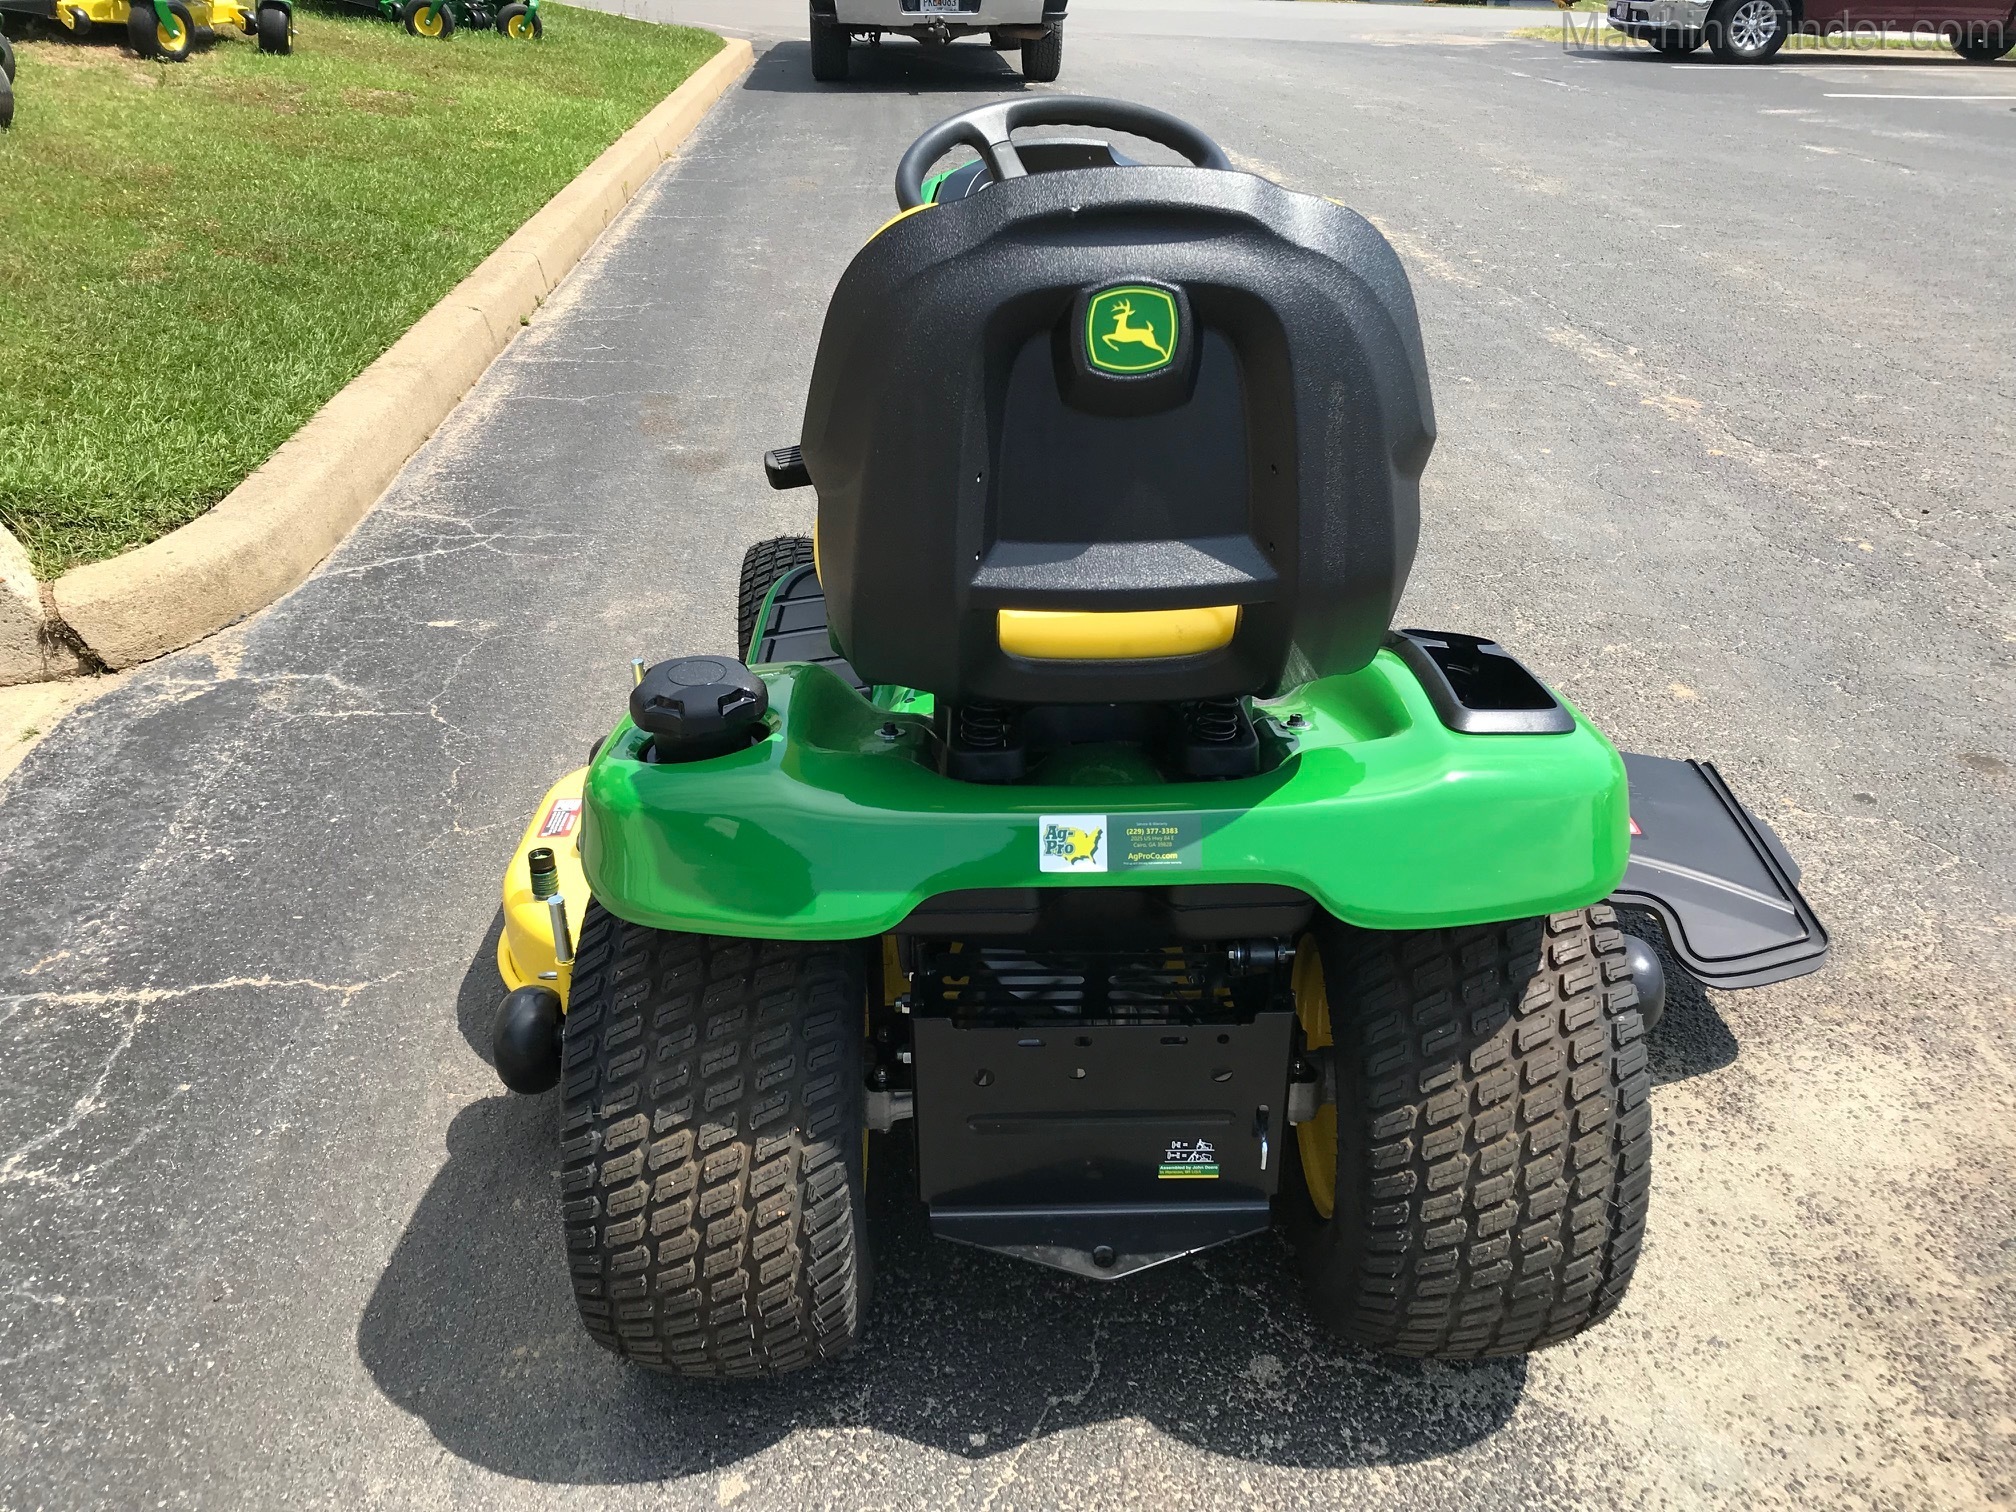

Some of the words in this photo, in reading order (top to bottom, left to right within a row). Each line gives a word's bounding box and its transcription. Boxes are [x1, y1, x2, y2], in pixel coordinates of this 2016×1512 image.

[1045, 825, 1074, 843] Ag-
[1126, 828, 1145, 836] (229)
[1045, 840, 1074, 855] Pro
[1127, 852, 1178, 862] AgProCo.com
